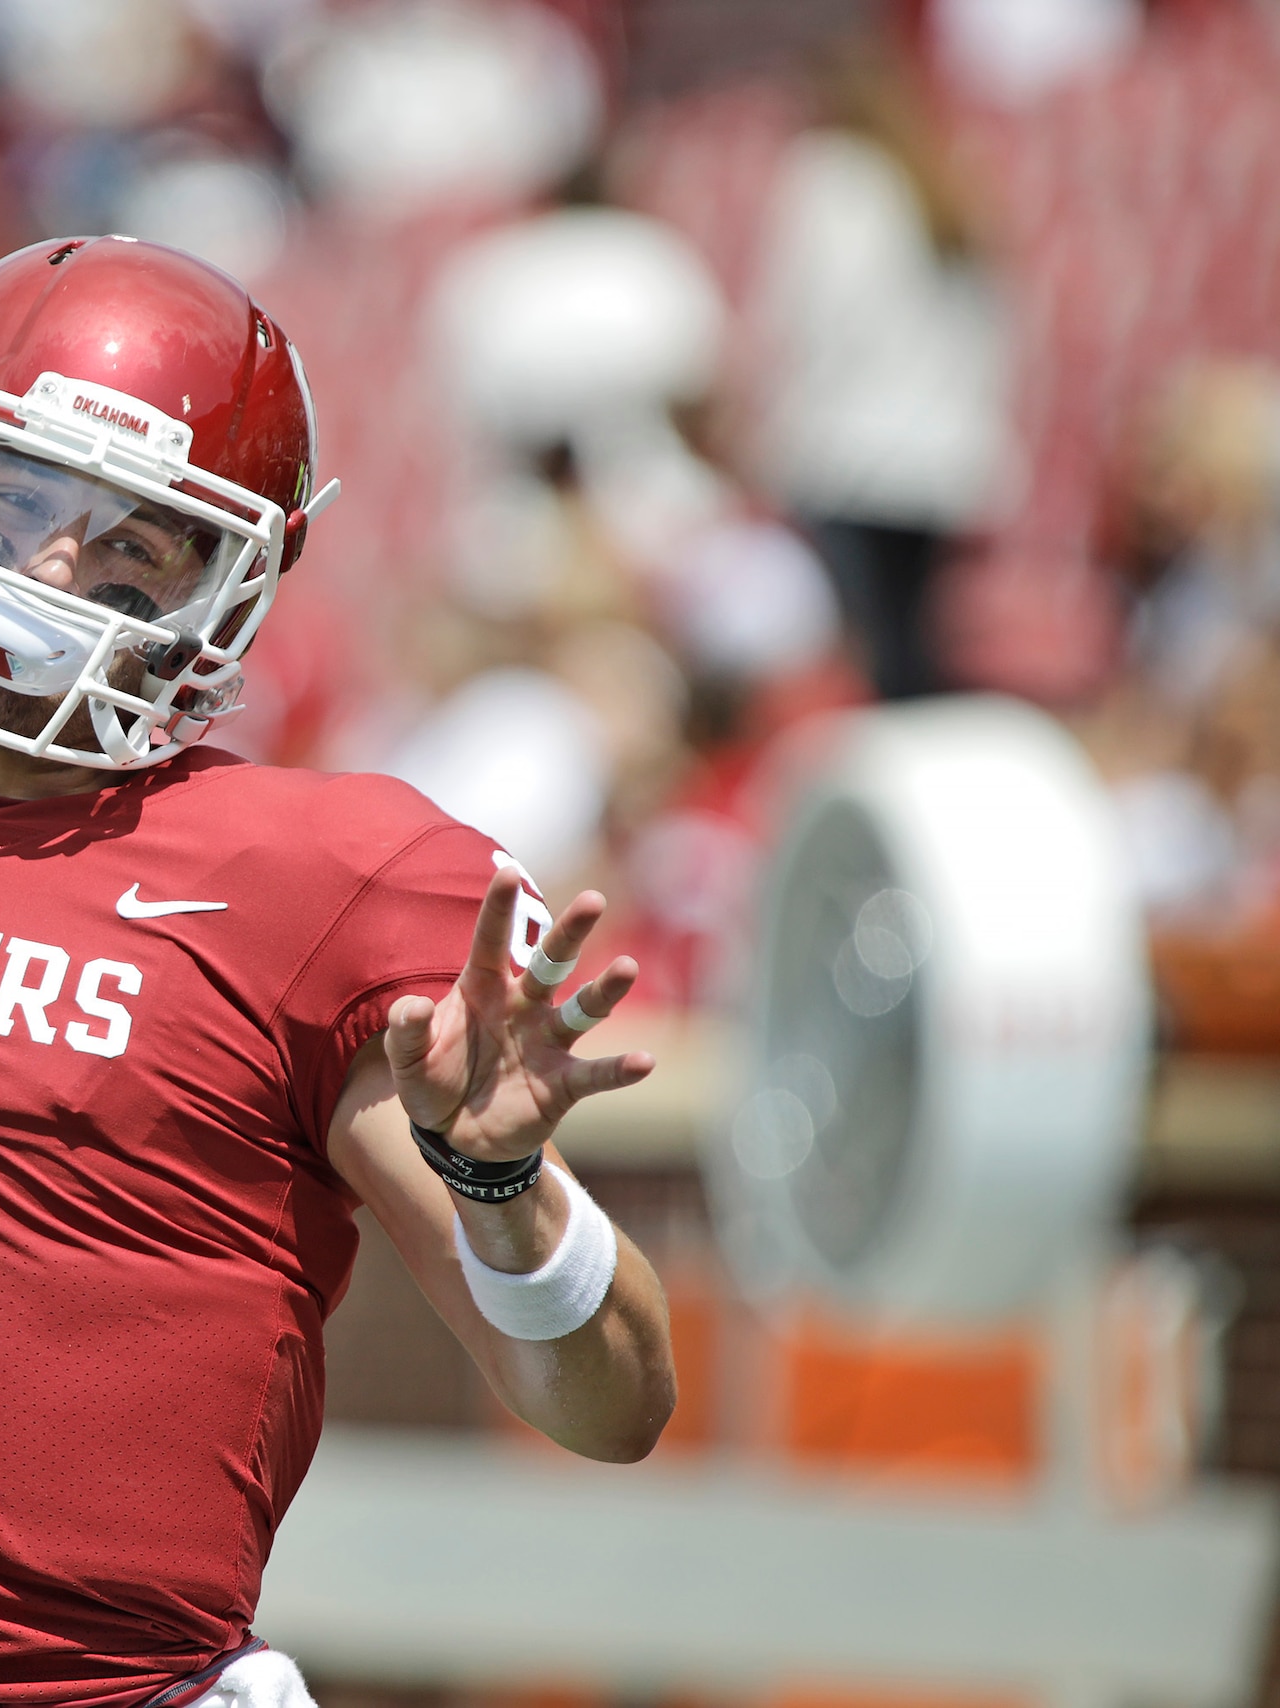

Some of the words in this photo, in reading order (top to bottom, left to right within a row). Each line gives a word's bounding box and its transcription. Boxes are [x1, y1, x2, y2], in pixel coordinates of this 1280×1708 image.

[73, 395, 150, 436] OKLAHOMA
[441, 1172, 488, 1198] DON'T
[493, 1180, 526, 1198] LET
